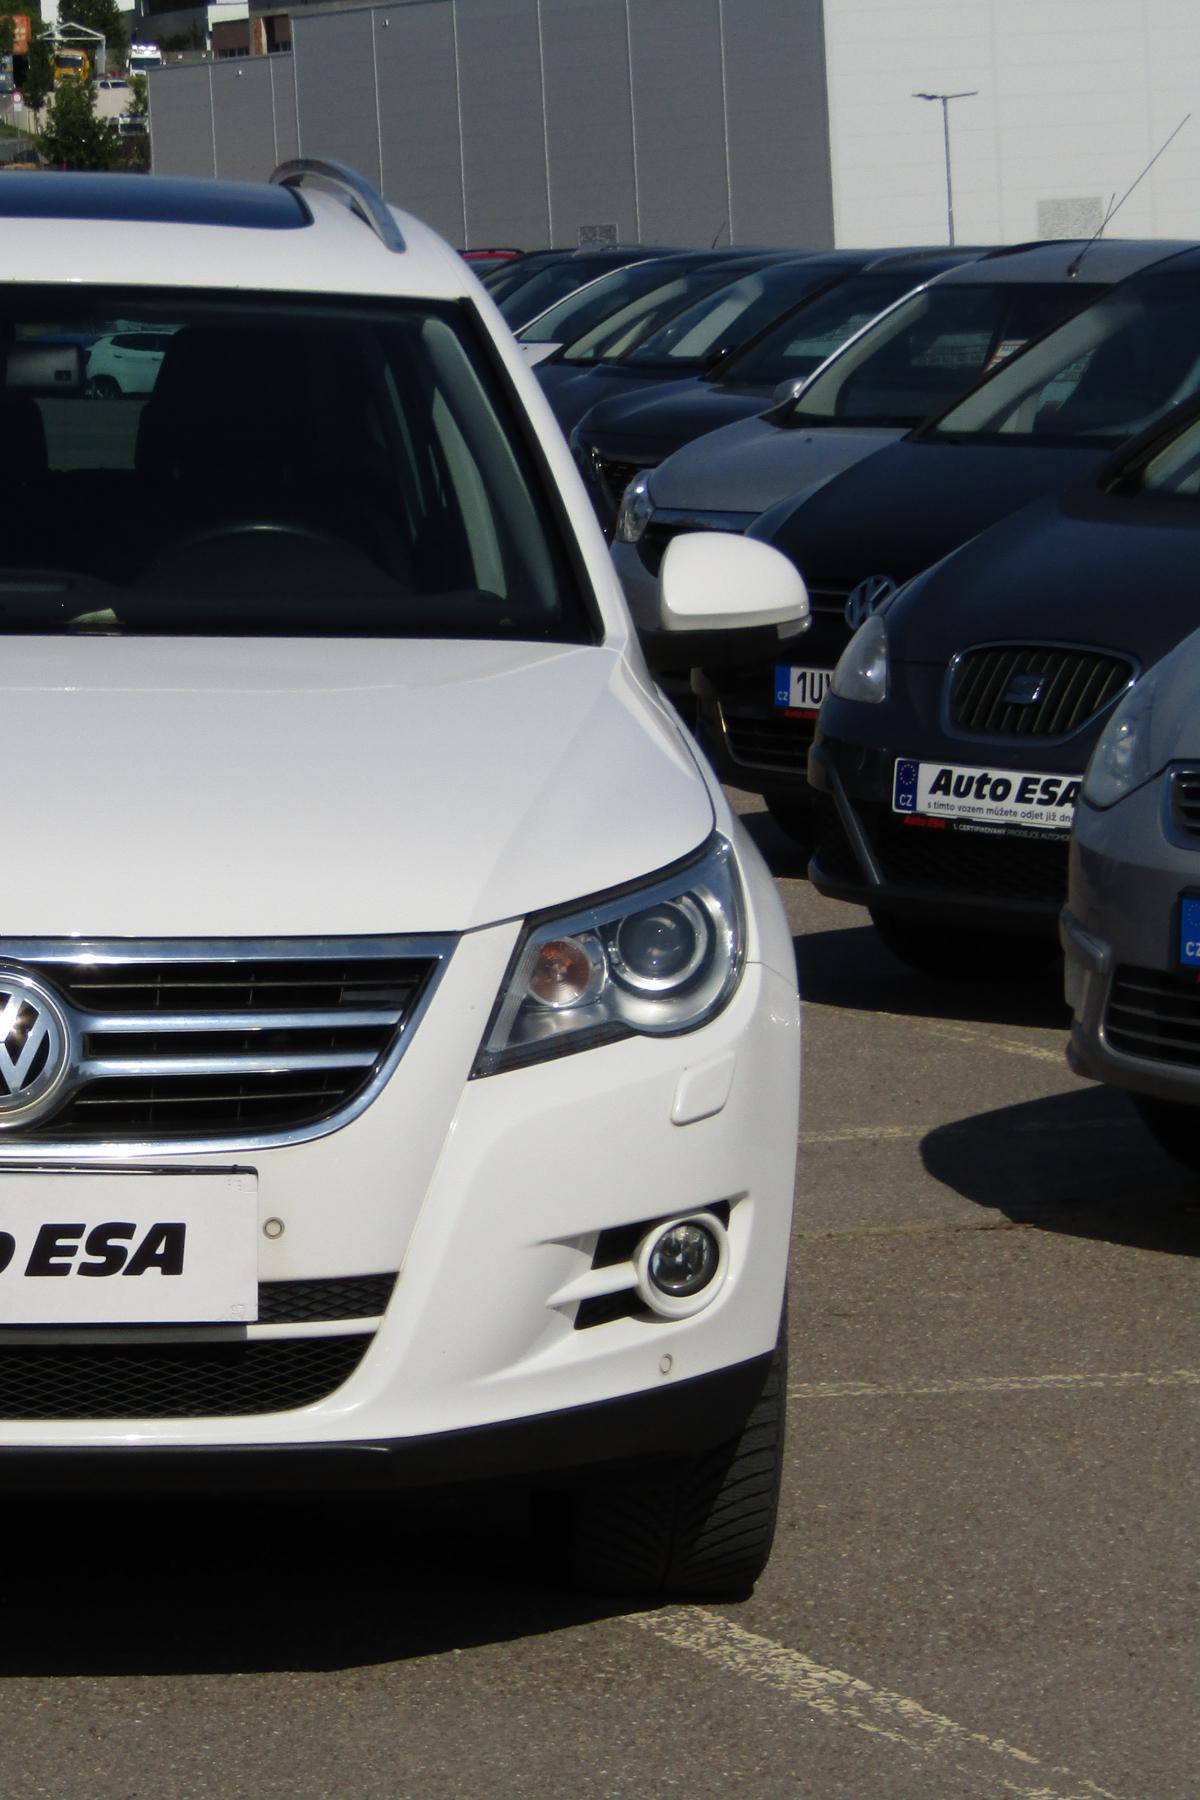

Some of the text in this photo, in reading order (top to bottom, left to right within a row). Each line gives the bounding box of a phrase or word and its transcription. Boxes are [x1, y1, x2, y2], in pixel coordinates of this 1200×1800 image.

[899, 793, 913, 807] CZ
[928, 768, 1082, 808] Auto ESA
[957, 804, 984, 815] vozem
[1020, 809, 1044, 820] odjet
[25, 1222, 186, 1277] ESA
